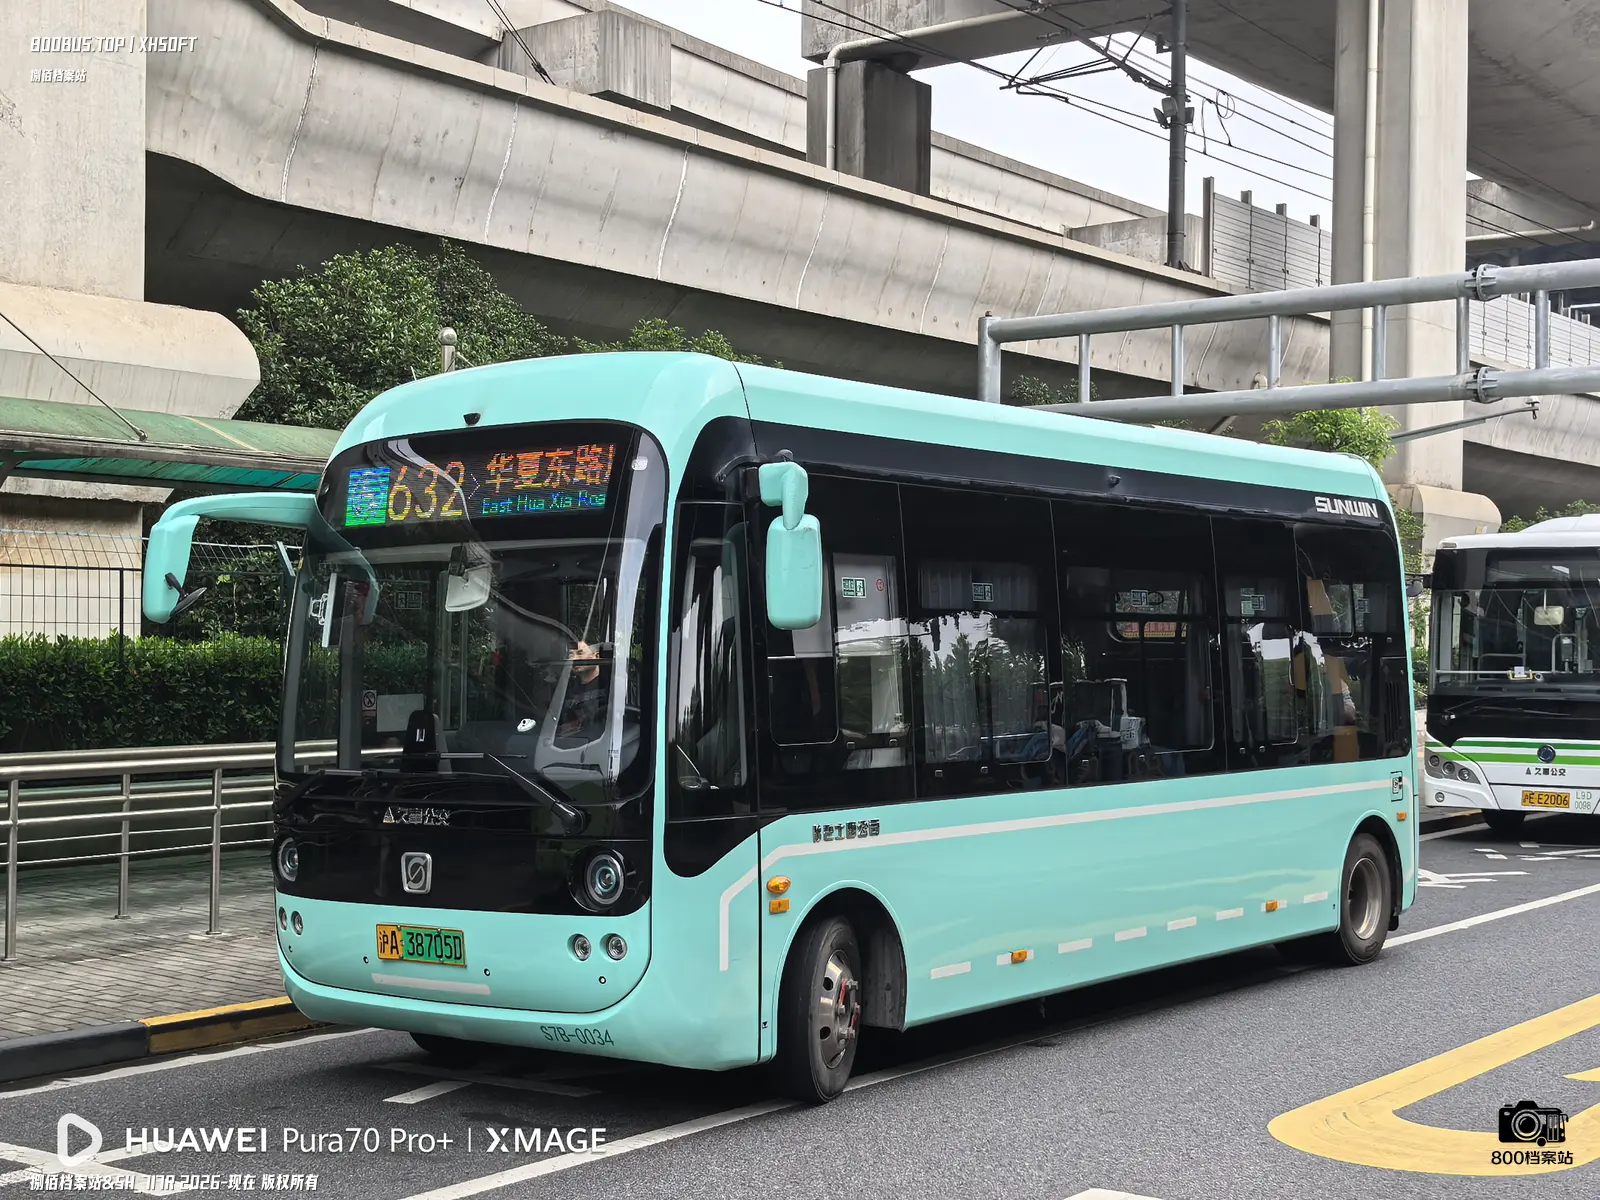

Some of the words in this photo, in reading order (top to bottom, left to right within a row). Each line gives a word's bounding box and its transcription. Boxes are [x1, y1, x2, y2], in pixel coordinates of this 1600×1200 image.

[484, 444, 615, 494] 华夏东路
[388, 461, 465, 520] 632
[482, 497, 513, 514] East
[517, 494, 545, 511] Hua
[550, 491, 573, 508] Xia
[1314, 496, 1379, 518] SUNWIN
[539, 1025, 615, 1046] S7B-0034
